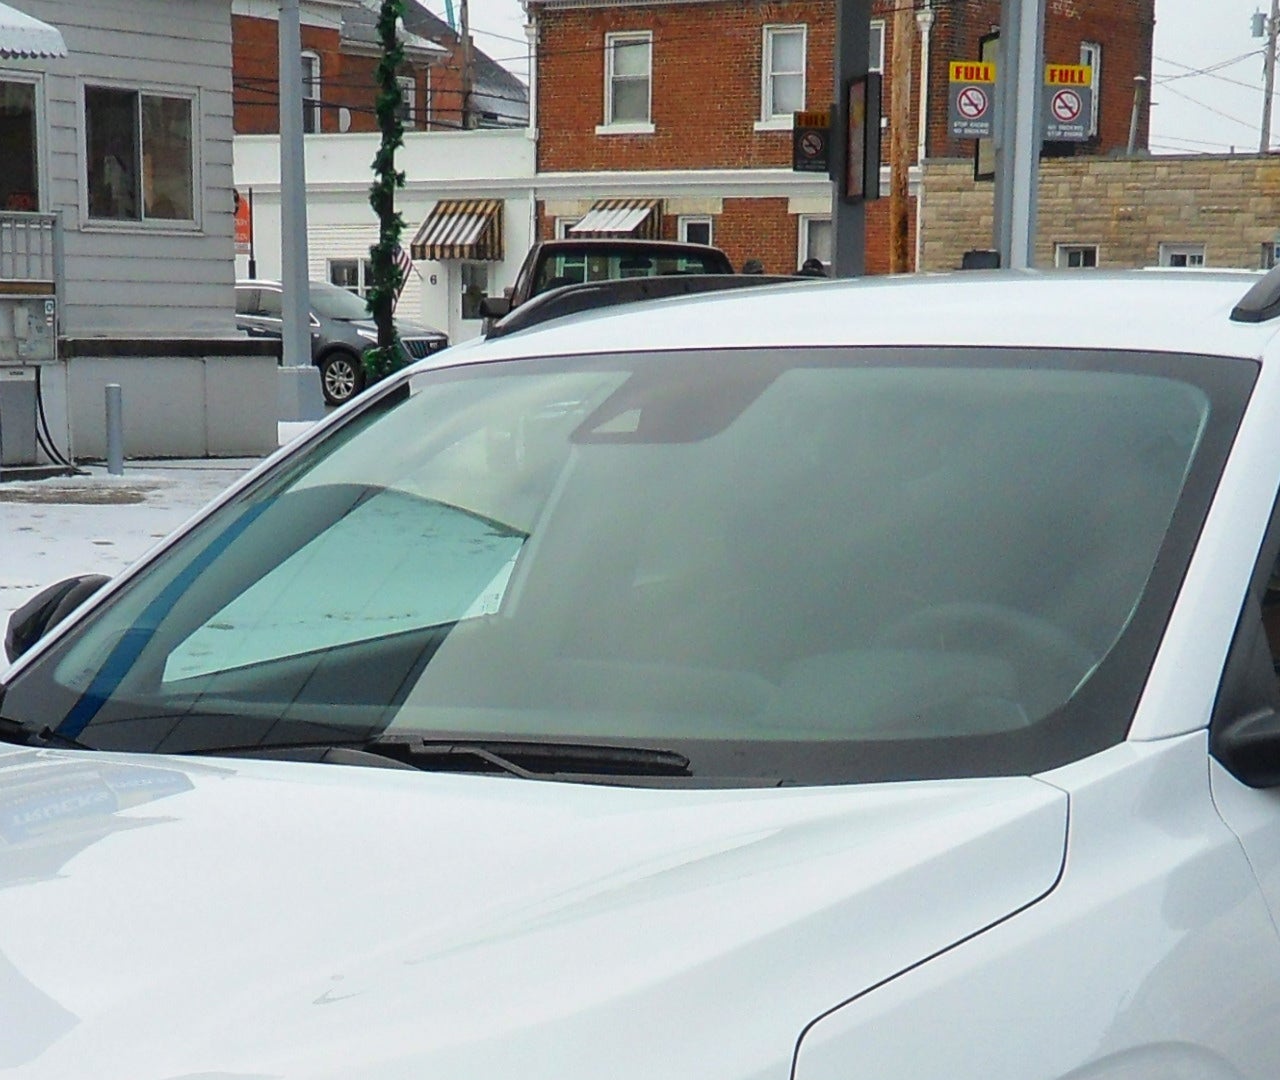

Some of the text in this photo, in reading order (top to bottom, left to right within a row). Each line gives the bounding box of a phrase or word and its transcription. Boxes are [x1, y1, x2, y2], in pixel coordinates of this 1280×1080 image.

[955, 66, 991, 81] FULL
[1049, 69, 1086, 83] FULL
[430, 274, 437, 286] 6
